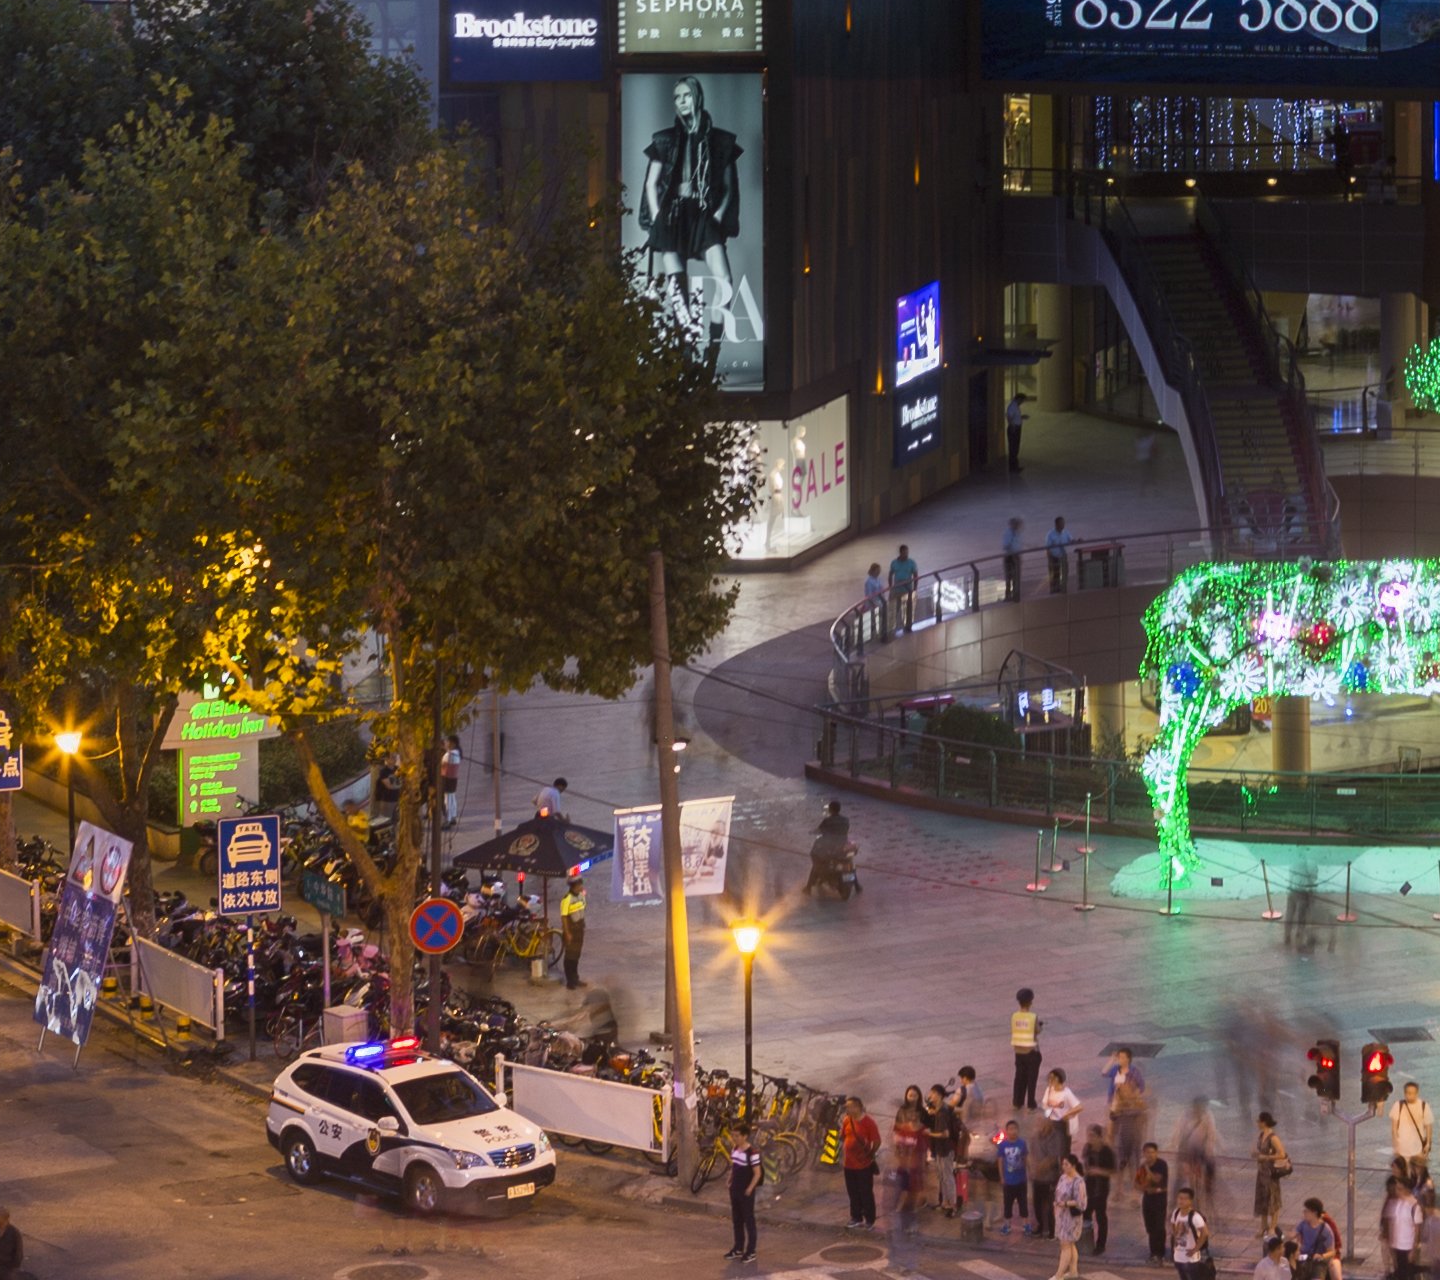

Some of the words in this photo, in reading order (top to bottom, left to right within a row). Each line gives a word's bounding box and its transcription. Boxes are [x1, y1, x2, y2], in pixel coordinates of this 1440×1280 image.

[453, 12, 598, 38] Brookstone
[792, 441, 845, 511] SALE
[181, 719, 242, 740] Holiday
[241, 715, 266, 735] Inn
[222, 869, 279, 889] 道路东侧
[222, 889, 278, 909] 依次停放
[318, 1119, 343, 1140] 公安
